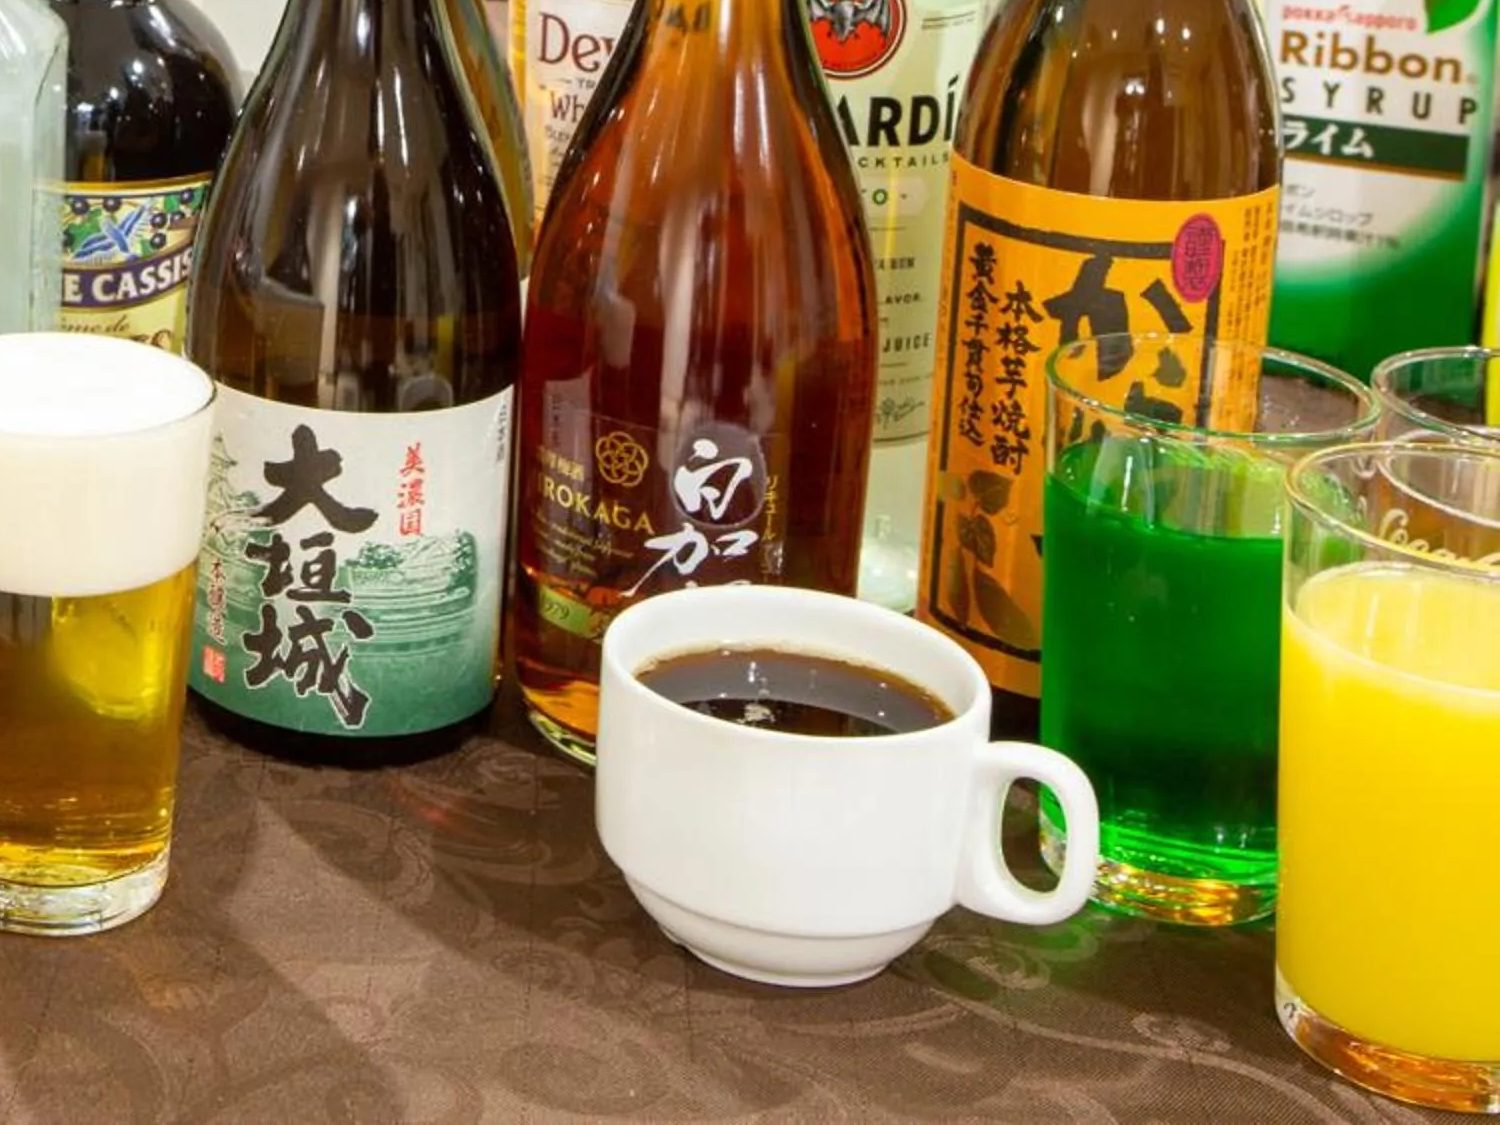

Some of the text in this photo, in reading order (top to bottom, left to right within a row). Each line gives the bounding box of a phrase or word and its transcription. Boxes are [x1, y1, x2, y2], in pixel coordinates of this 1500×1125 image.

[1281, 28, 1463, 85] Ribbon
[1281, 76, 1479, 125] SYRUP
[1284, 120, 1375, 158] ライム
[883, 332, 931, 353] JUICE
[243, 423, 380, 730] 大垣城
